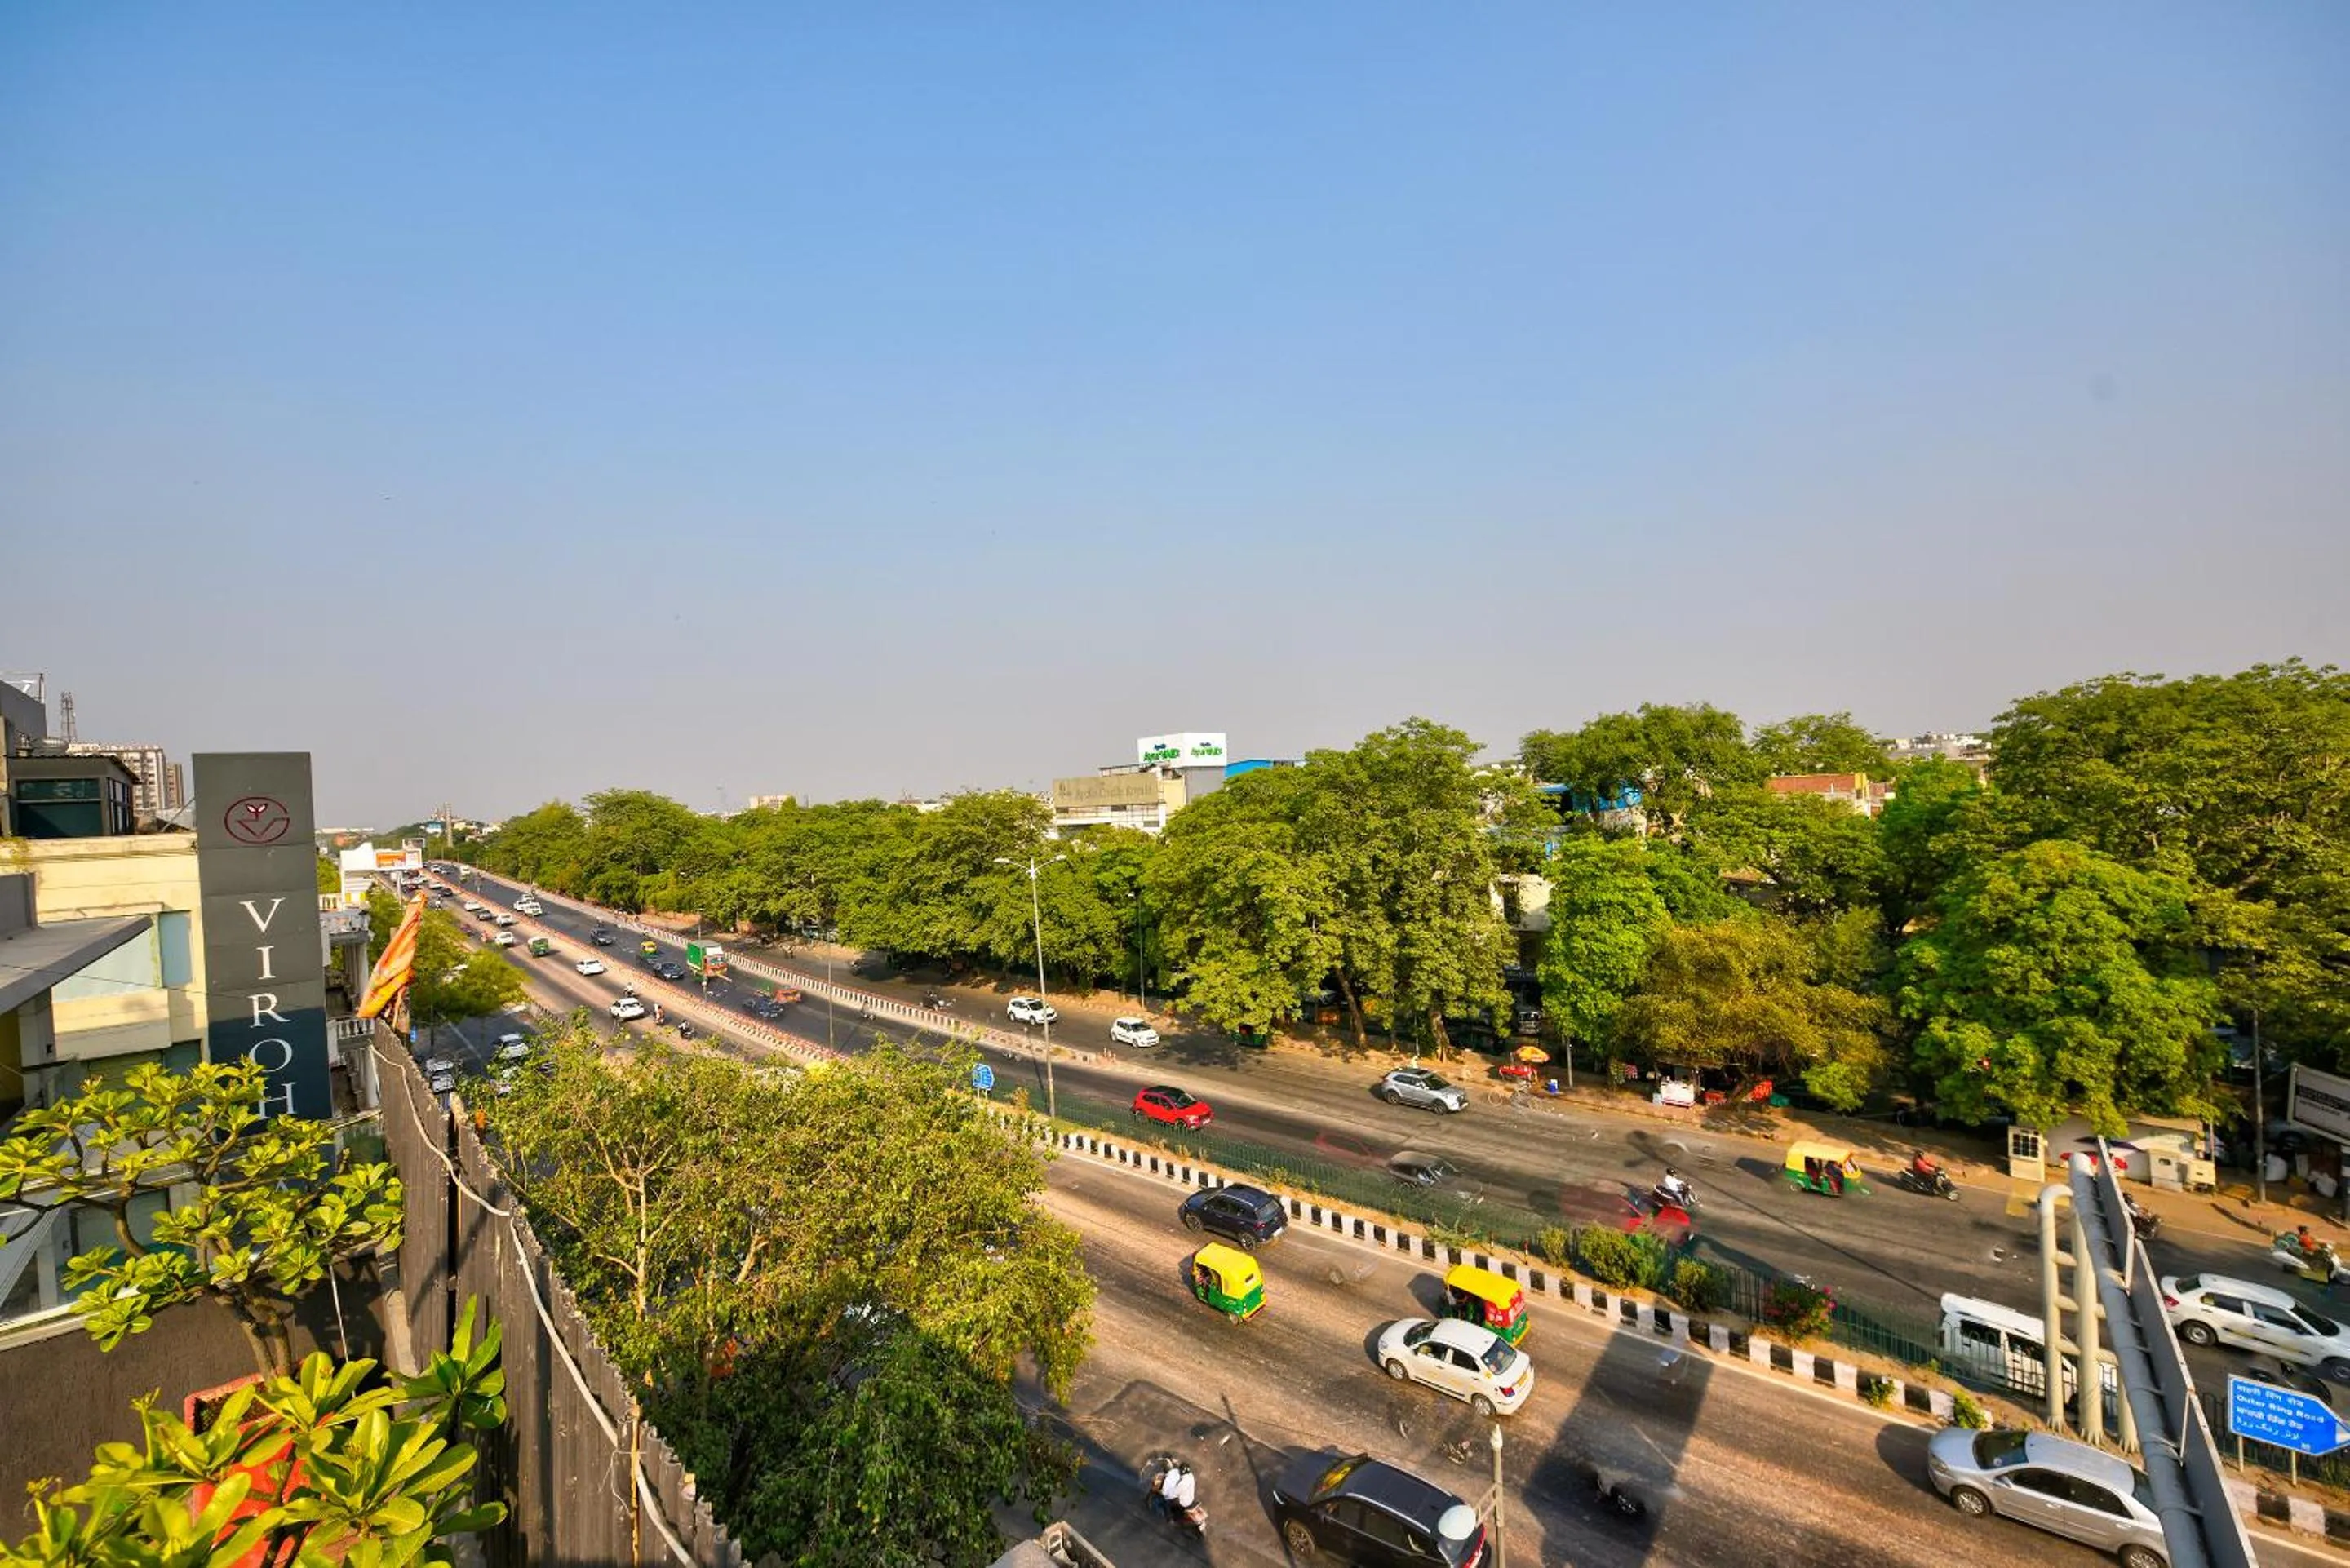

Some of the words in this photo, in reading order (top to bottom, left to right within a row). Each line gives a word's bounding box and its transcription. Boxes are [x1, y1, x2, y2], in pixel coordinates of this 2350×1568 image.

[239, 897, 296, 1119] VIROH
[2237, 1395, 2265, 1407] Outer
[2268, 1402, 2293, 1416] Ring
[2296, 1410, 2325, 1424] Road
